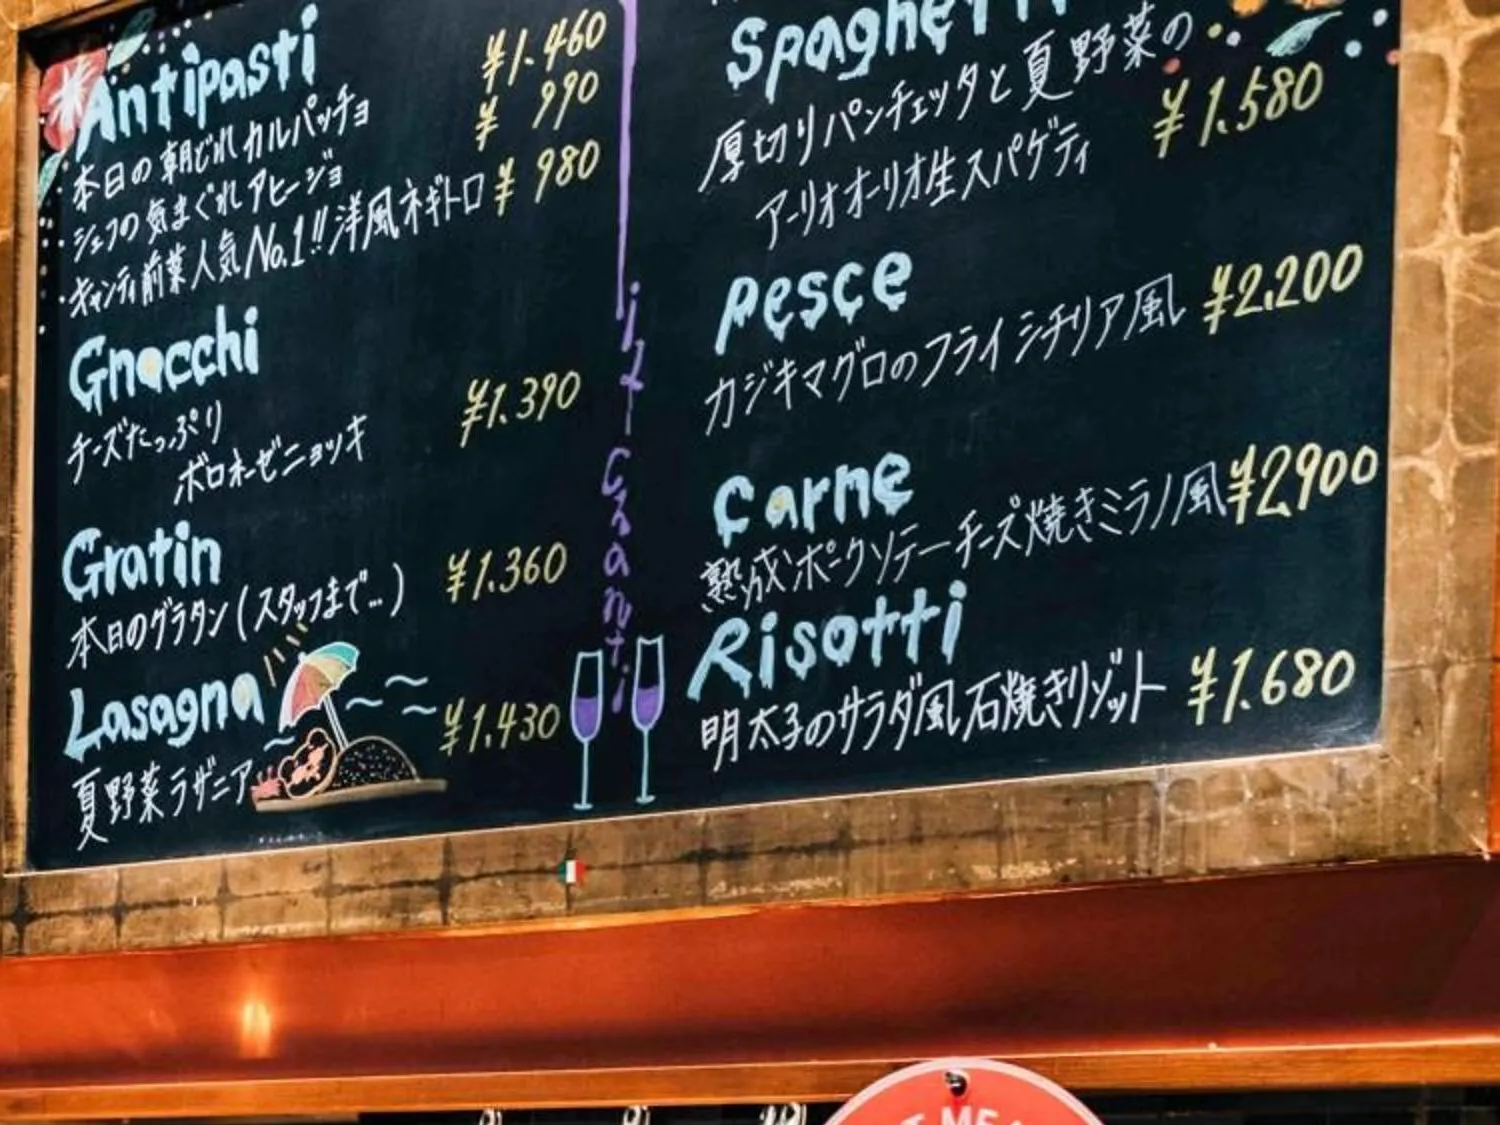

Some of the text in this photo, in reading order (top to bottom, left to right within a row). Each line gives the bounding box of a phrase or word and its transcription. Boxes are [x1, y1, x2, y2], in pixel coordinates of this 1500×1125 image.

[76, 5, 318, 160] Antipasti
[726, 0, 1068, 104] Spaghe
[69, 304, 260, 416] Gnocchi
[67, 400, 223, 485] チーズたっぷり
[174, 413, 367, 505] ボロネーゼニョッキ
[714, 451, 913, 546] Carne
[62, 519, 221, 603] Gratin
[687, 580, 968, 701] Risotti
[62, 671, 265, 762] Lasagna
[72, 757, 257, 851] 夏野菜ラザニア
